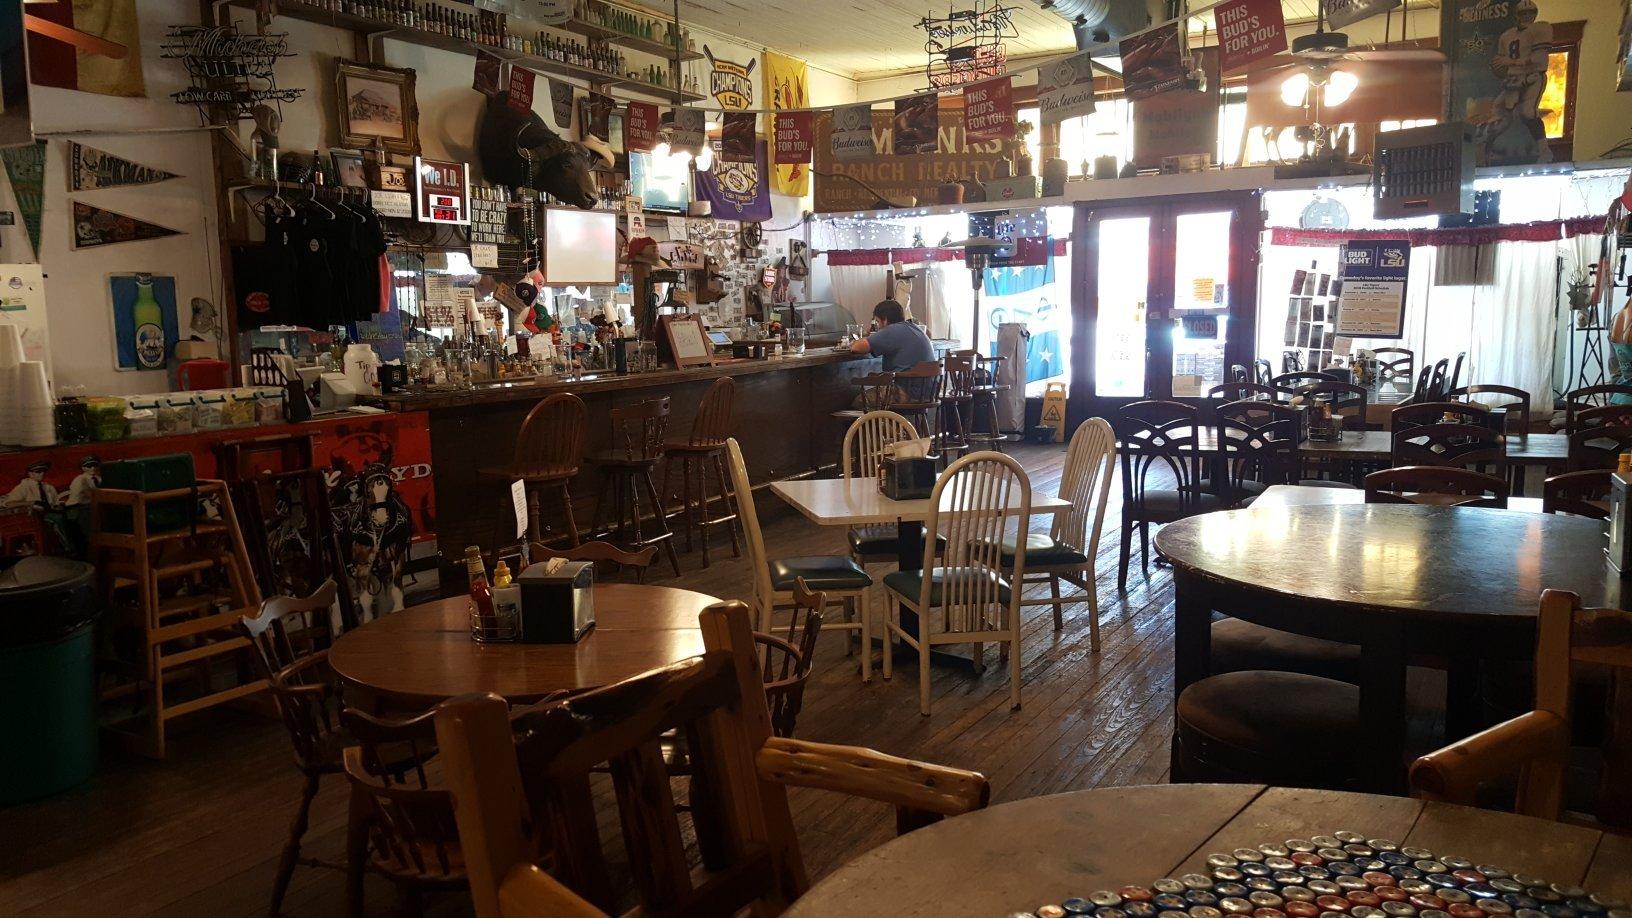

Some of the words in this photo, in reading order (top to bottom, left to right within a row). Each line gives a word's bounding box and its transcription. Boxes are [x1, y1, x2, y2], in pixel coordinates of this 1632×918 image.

[1219, 4, 1248, 25] THIS
[1222, 15, 1260, 40] BUD'S
[167, 25, 289, 57] Michelob
[1225, 37, 1250, 55] FOR
[1251, 25, 1280, 43] YOU.
[513, 70, 524, 82] THIS
[511, 80, 526, 93] BUD'S
[711, 72, 752, 104] CHAMPIONS
[510, 91, 521, 100] FOR
[520, 94, 530, 104] YOU.
[724, 94, 742, 108] LSU
[968, 90, 987, 104] THIS
[631, 107, 644, 118] THIS
[968, 101, 995, 115] BUD'S
[630, 118, 647, 128] BUD'S
[778, 119, 794, 129] THIS
[968, 116, 986, 130] FOR
[986, 112, 1008, 127] YOU.
[629, 128, 641, 138] FOR
[778, 130, 800, 140] BUD'S
[778, 141, 792, 151] FOR
[793, 141, 809, 151] YOU.
[424, 165, 441, 185] We
[832, 162, 905, 182] RANCH
[918, 160, 998, 181] REALTY
[472, 199, 481, 209] YOU
[482, 200, 495, 211] DON'T
[496, 202, 507, 212] HAVE
[472, 210, 479, 222] TO
[480, 210, 488, 223] BE
[489, 212, 507, 224] CRAZY
[472, 222, 478, 231] TO
[479, 223, 492, 233] WORK
[1380, 258, 1406, 268] LSU
[1184, 319, 1216, 332] CLOSED
[355, 360, 371, 371] Tip
